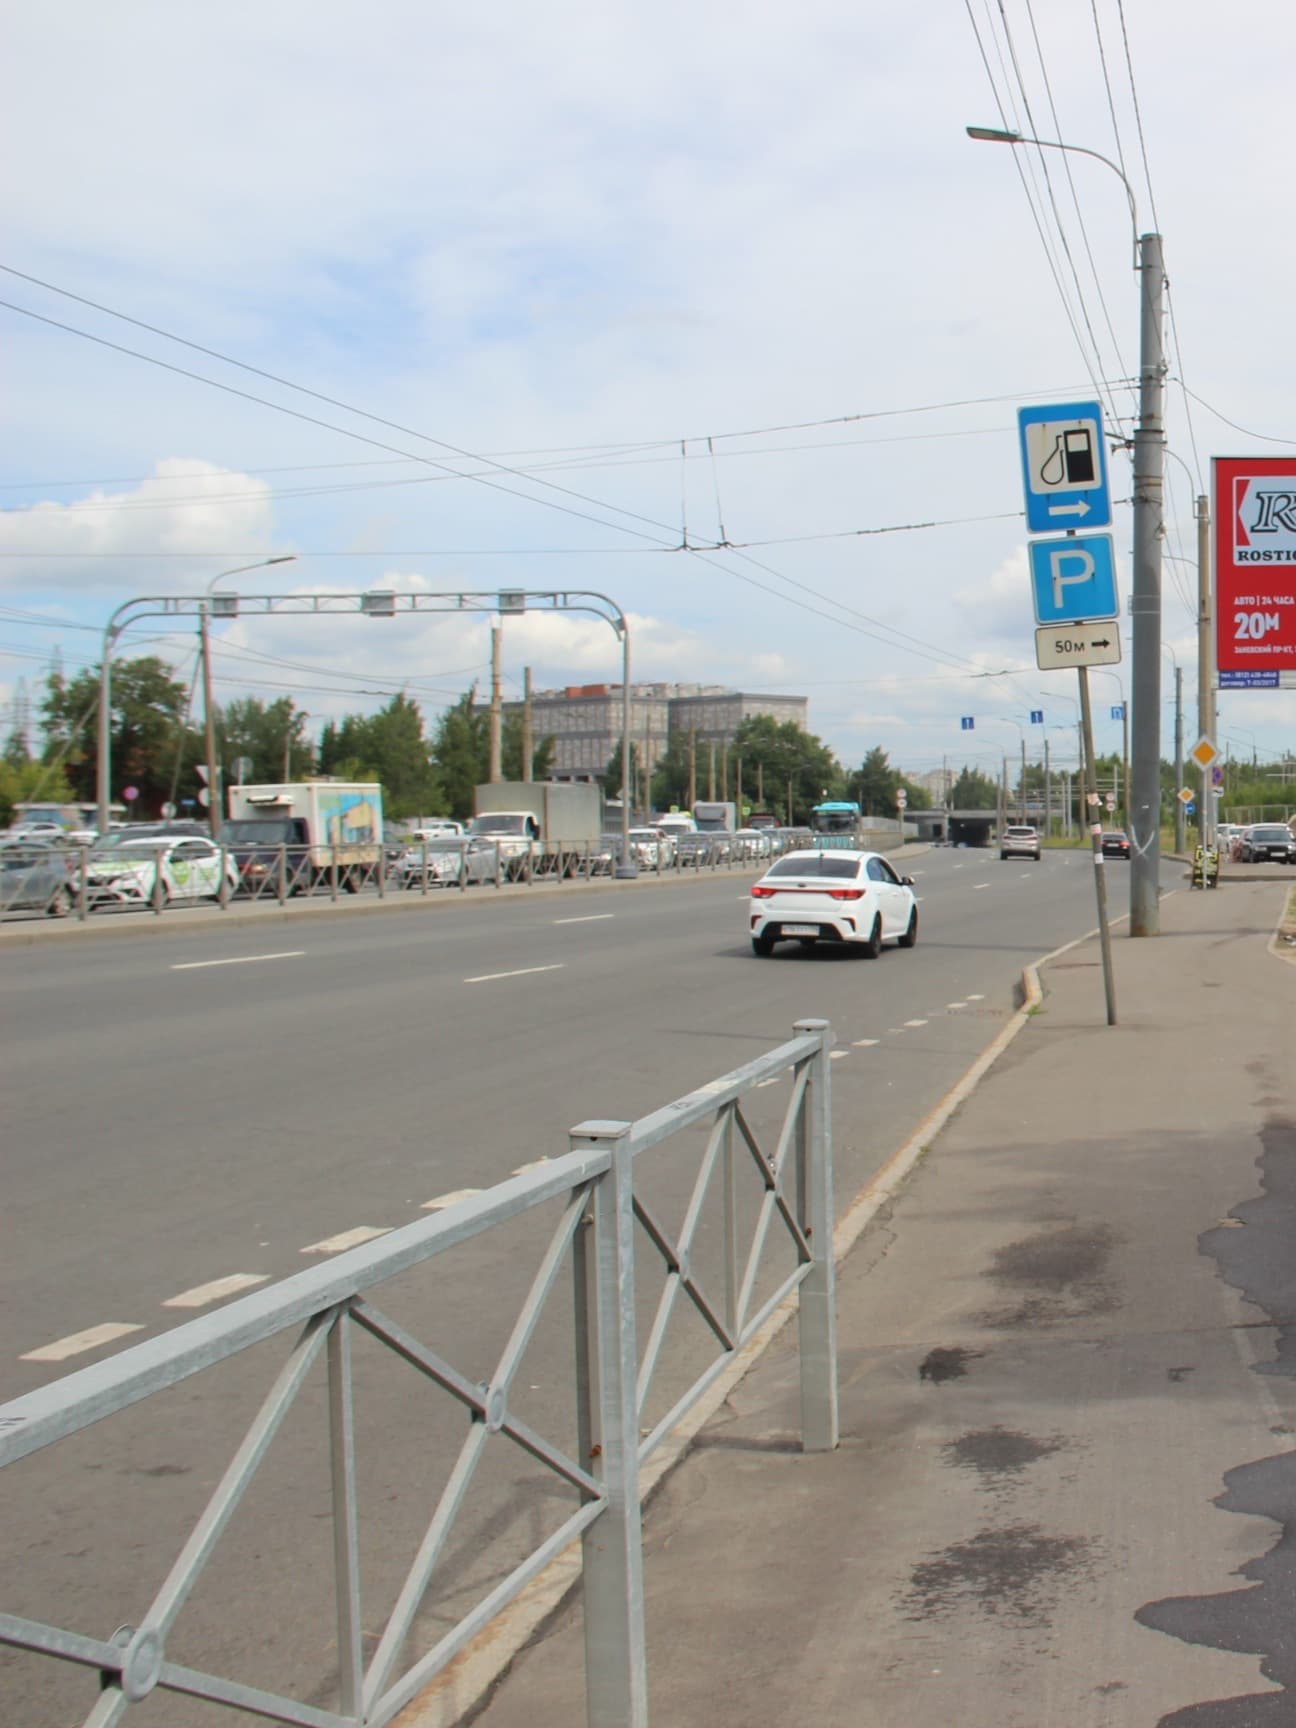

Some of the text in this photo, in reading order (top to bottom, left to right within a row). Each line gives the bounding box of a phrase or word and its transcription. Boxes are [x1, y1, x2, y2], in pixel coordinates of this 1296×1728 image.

[1050, 549, 1095, 609] P
[1234, 596, 1295, 605] АВТО 24 ЧАСА
